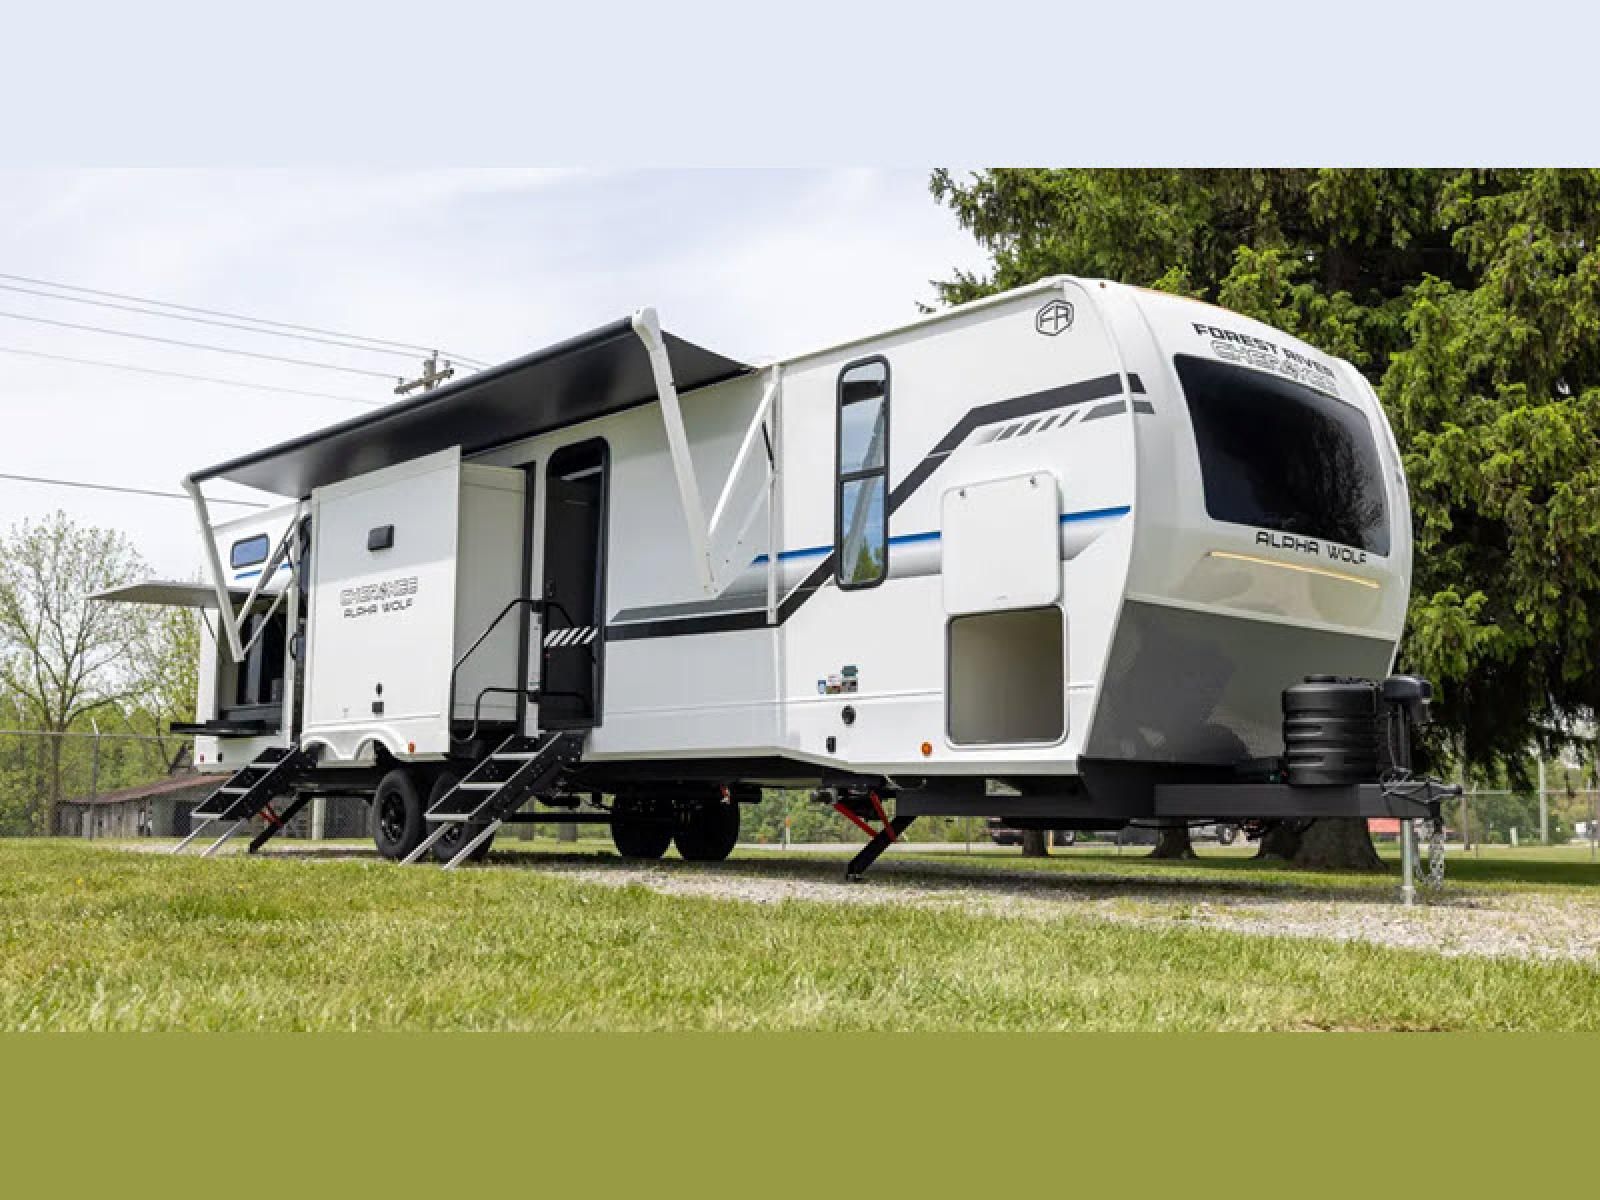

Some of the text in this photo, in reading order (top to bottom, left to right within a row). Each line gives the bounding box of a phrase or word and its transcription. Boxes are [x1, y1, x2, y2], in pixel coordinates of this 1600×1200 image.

[1191, 322, 1279, 354] FOREST
[1255, 531, 1367, 565] ALPHA WOLF
[343, 598, 413, 618] ALPHA WOLF
